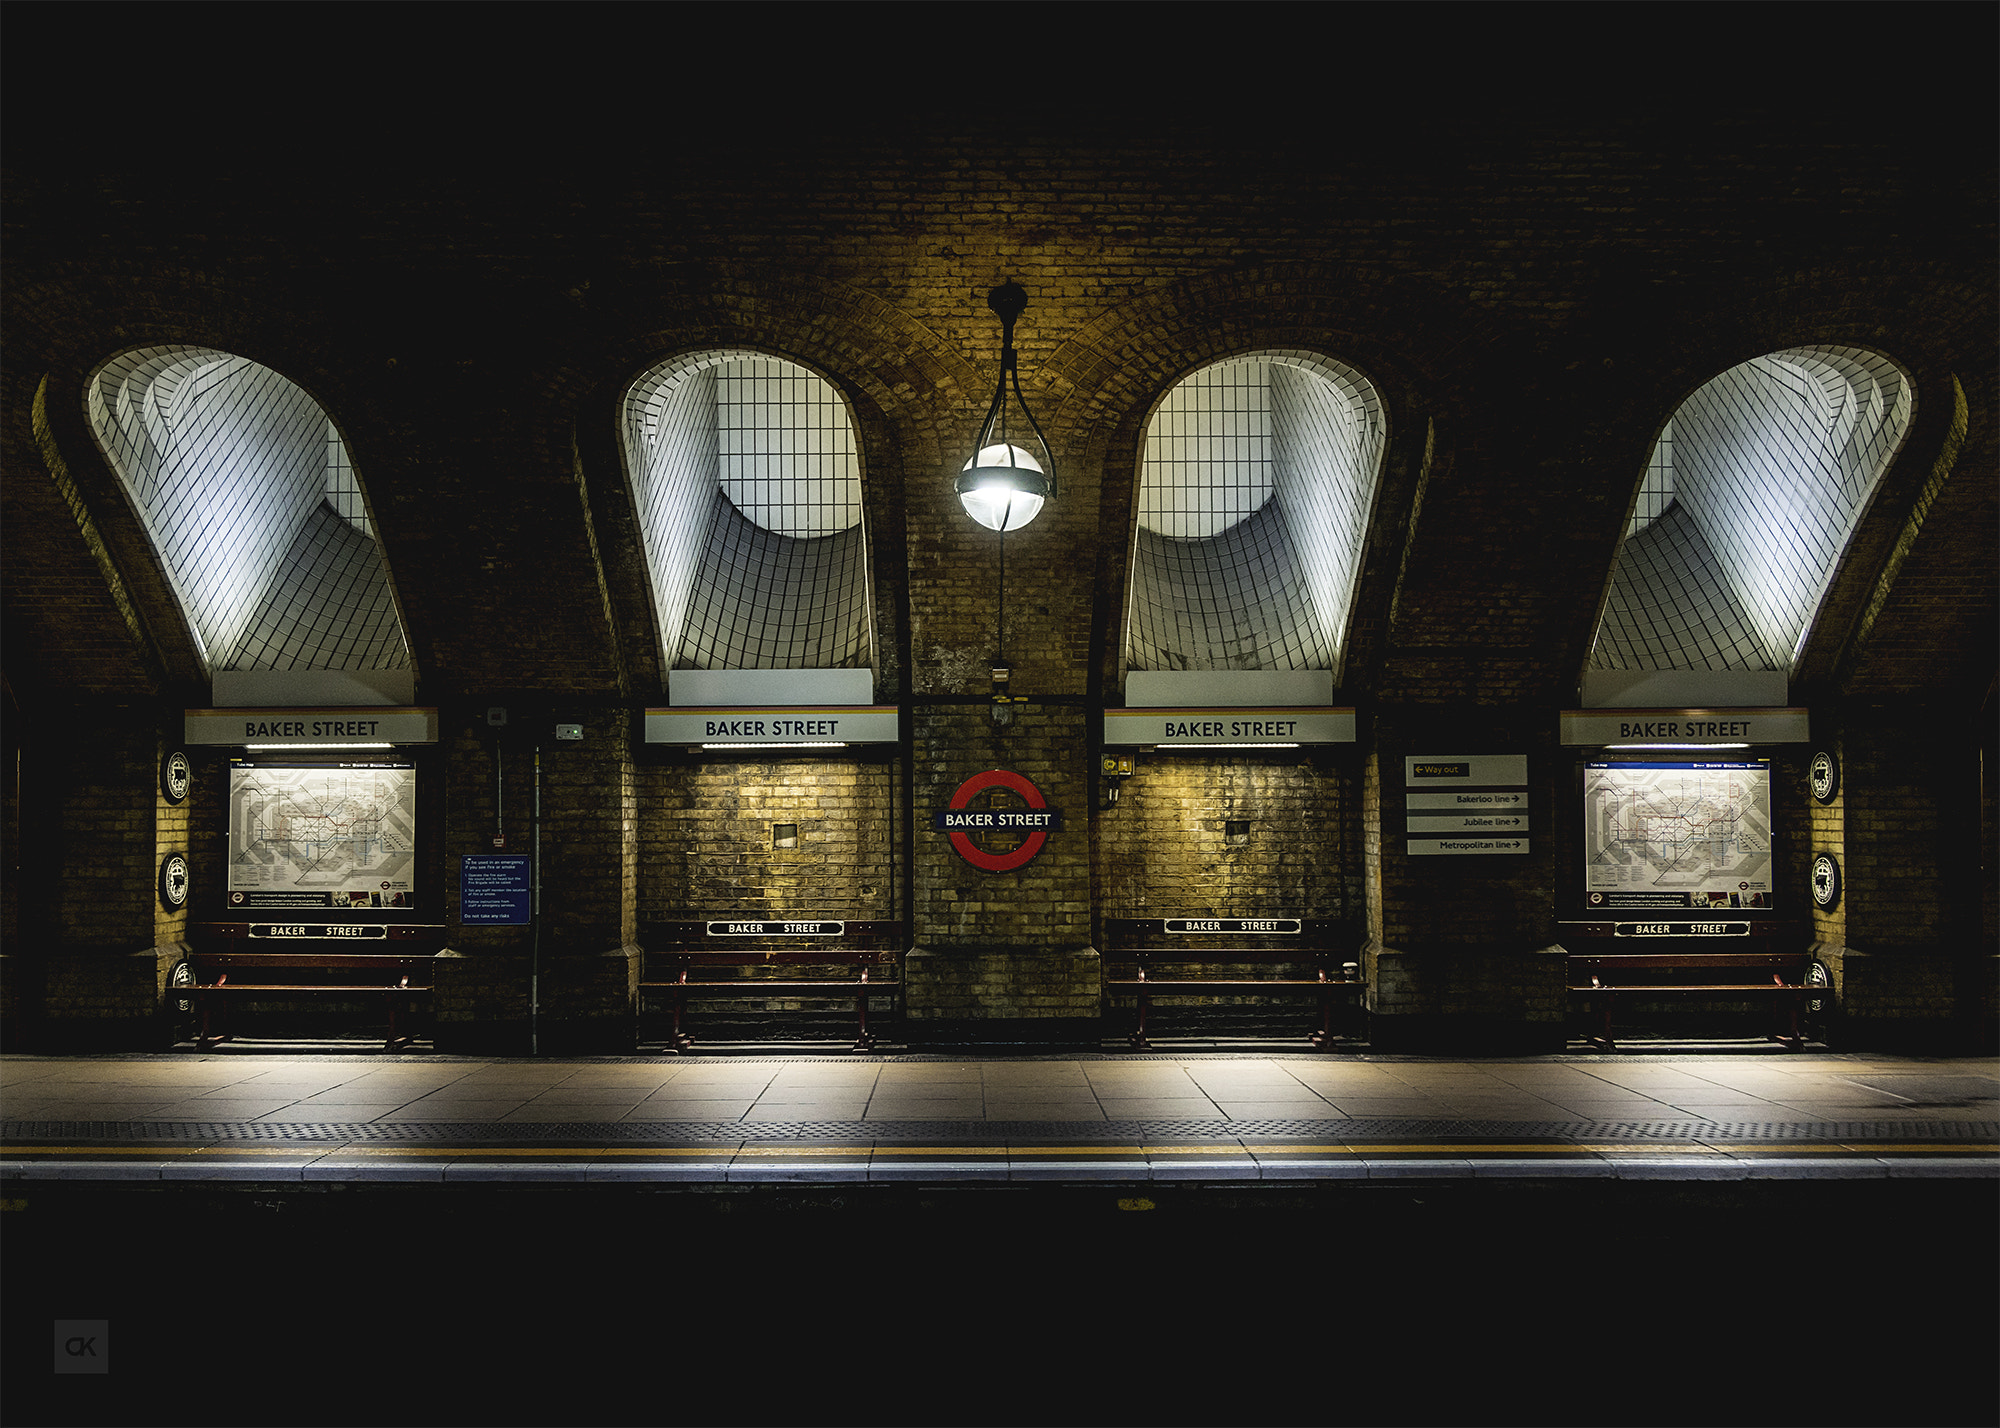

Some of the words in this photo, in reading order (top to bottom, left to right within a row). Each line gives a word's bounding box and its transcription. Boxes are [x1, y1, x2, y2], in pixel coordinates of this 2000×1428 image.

[246, 722, 305, 737] BAKER
[313, 721, 378, 736] STREET
[707, 722, 765, 736] BAKER
[773, 721, 838, 736] STREET
[1166, 722, 1224, 737] BAKER
[1232, 722, 1296, 736] STREET
[1621, 723, 1679, 737] BAKER
[1686, 722, 1750, 737] STREET
[1425, 766, 1442, 775] Way
[1456, 795, 1493, 803] Bakerloo
[1494, 795, 1510, 803] line
[946, 814, 994, 827] BAKER
[999, 814, 1052, 826] STREET
[1463, 818, 1493, 826] Jubilee
[1495, 818, 1511, 826] line
[1440, 841, 1494, 850] Metropolitan
[1495, 841, 1511, 849] line
[270, 926, 306, 936] BAKER
[326, 927, 364, 936] STREET
[728, 923, 763, 933] BAKER
[784, 923, 821, 933] STREET
[1186, 921, 1221, 931] BAKER
[1241, 921, 1278, 931] STREET
[1635, 924, 1670, 934] BAKER
[1690, 924, 1727, 933] STREET
